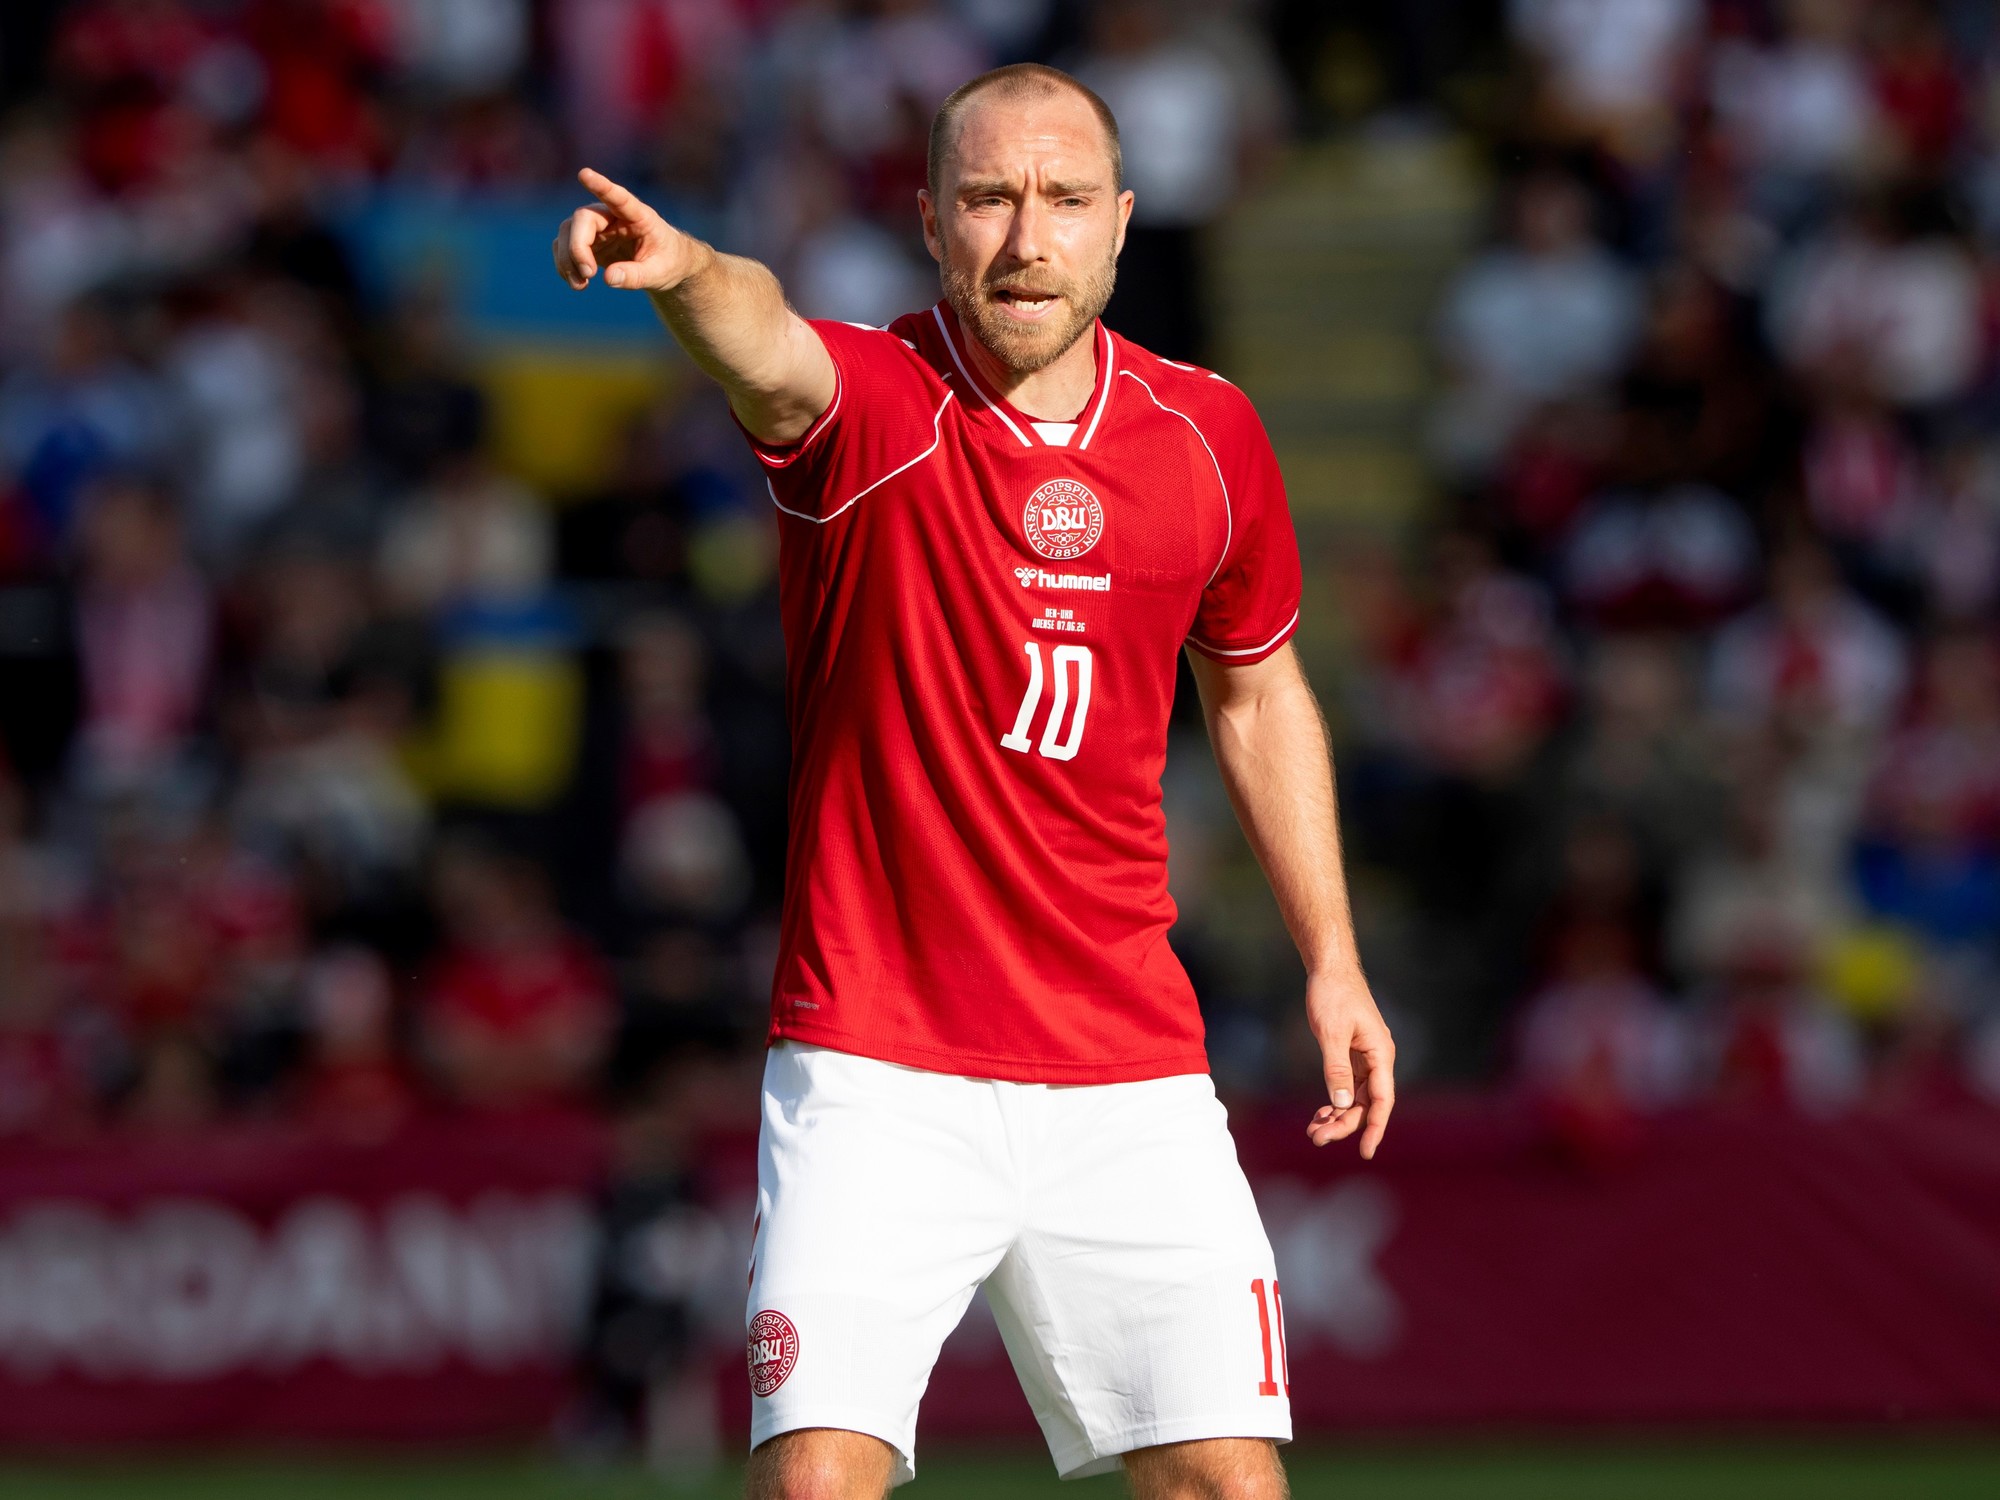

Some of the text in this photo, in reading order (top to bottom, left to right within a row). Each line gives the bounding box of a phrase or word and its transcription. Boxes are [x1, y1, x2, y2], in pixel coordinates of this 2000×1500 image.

[1027, 502, 1046, 550] DANSK
[1041, 507, 1086, 530] DBU
[1048, 546, 1079, 557] 1889
[1038, 569, 1111, 591] hummel
[1000, 641, 1092, 761] 10
[753, 1339, 782, 1365] DBU
[757, 1378, 776, 1391] 1889
